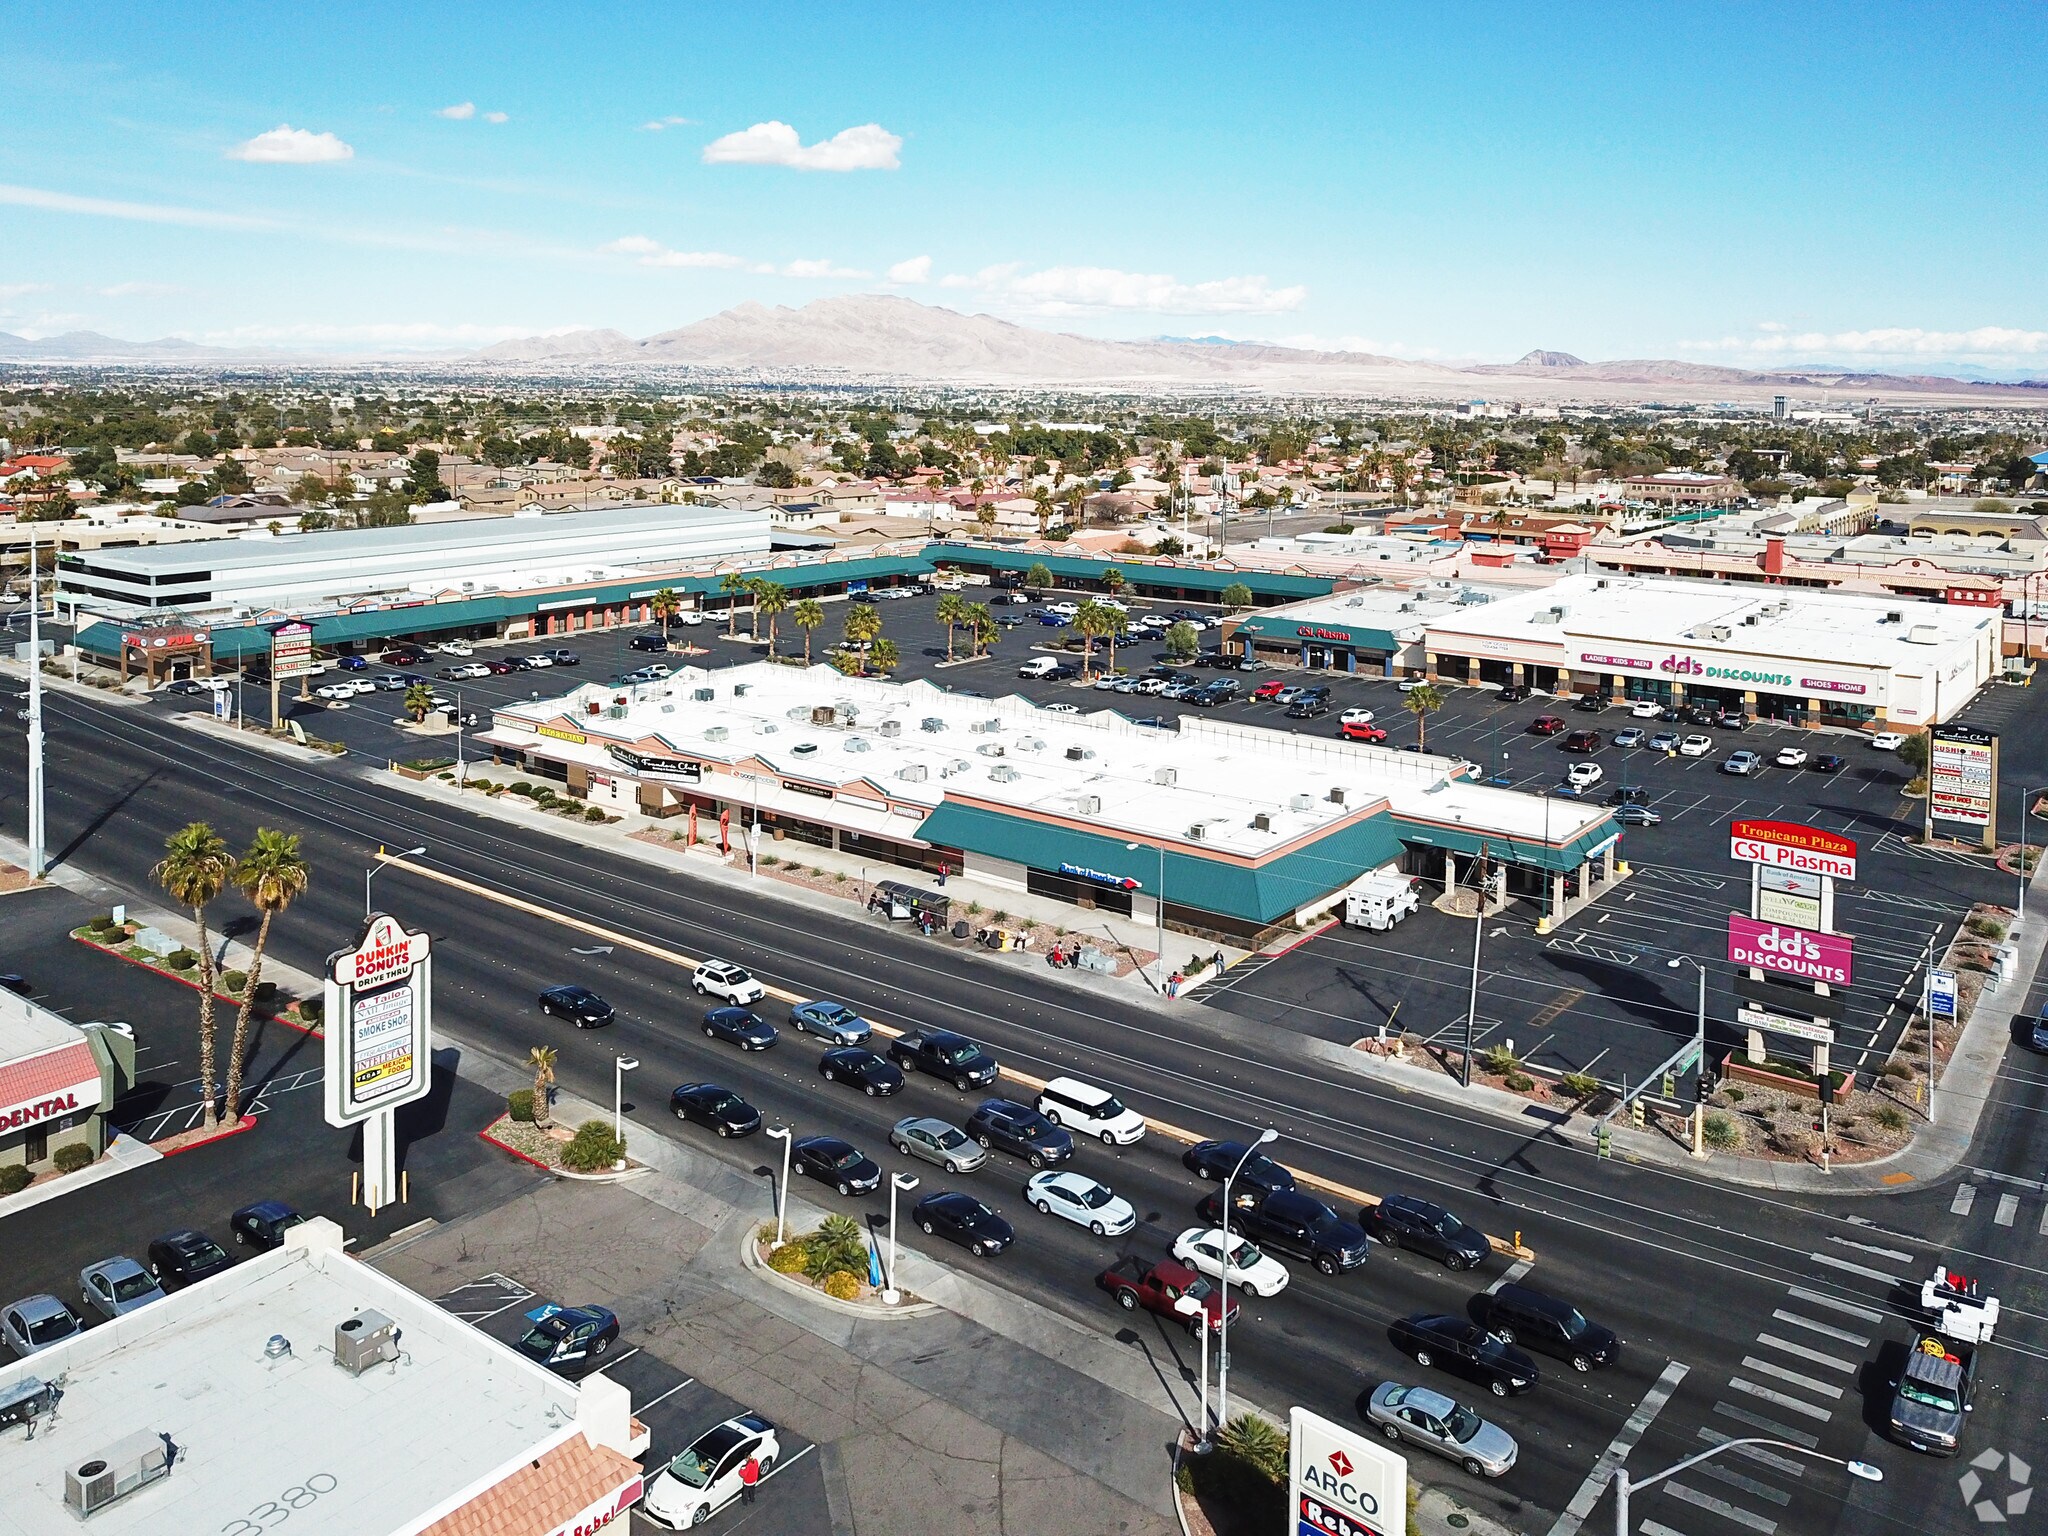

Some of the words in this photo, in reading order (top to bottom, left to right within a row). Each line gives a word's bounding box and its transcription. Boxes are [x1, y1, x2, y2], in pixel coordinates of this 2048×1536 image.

[167, 634, 193, 647] PUB
[1298, 626, 1314, 637] CSL
[1316, 627, 1351, 641] Plasma
[275, 663, 298, 671] SUSHI
[1584, 654, 1608, 664] LADIES
[1612, 657, 1629, 667] KIDS
[1633, 660, 1650, 669] MEN
[1660, 654, 1703, 675] dd's
[1706, 666, 1793, 687] DISCOUNTS
[1806, 679, 1832, 689] SHOES
[1838, 682, 1862, 693] HOME
[1934, 745, 1960, 754] SUSHI
[677, 762, 698, 772] Club
[1739, 823, 1807, 845] Tropicana
[1811, 836, 1848, 852] Plaza
[1734, 841, 1770, 861] CSL
[1777, 848, 1852, 876] Plasma
[1766, 868, 1782, 876] Bank
[1789, 873, 1815, 883] America
[1760, 906, 1817, 921] COMPOUNDING
[355, 940, 412, 966] DUNKIN'
[1757, 926, 1821, 960] dd's
[356, 952, 409, 978] DONUTS
[1733, 947, 1845, 981] DISCOUNTS
[358, 973, 385, 987] DRIVE
[386, 966, 408, 979] THRU
[373, 989, 406, 1004] Tailor
[358, 1021, 386, 1039] SMOKE
[387, 1013, 408, 1029] SHOP
[382, 1055, 411, 1070] MEXICAN
[387, 1064, 406, 1074] FOOD
[0, 1093, 79, 1132] DENTAL
[1304, 1465, 1378, 1515] ARCO
[221, 1473, 338, 1536] 3380
[573, 1505, 615, 1536] Rebel
